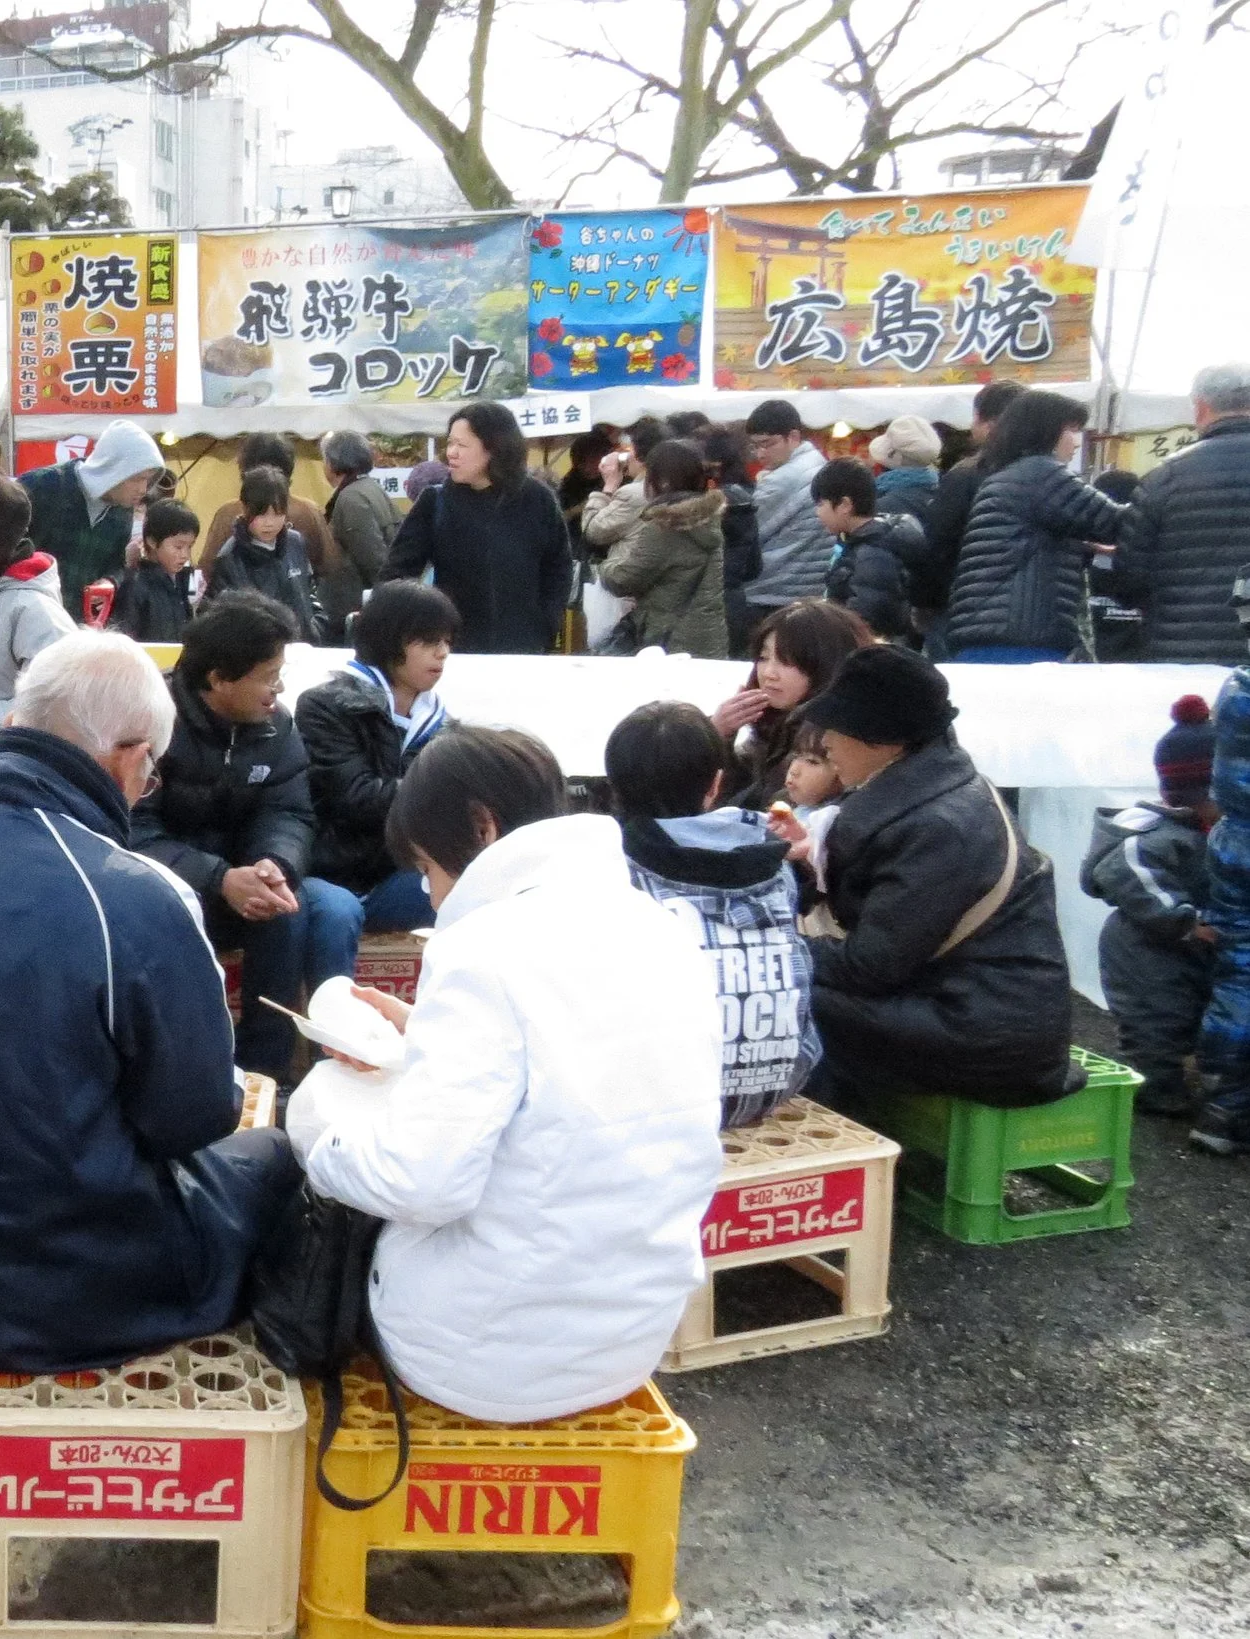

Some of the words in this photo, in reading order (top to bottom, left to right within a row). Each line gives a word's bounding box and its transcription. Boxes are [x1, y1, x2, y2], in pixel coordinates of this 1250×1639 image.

[579, 226, 655, 246] 谷ちゃんの
[530, 276, 699, 304] サーターアンダギー
[41, 302, 62, 357] 栗の実が
[755, 265, 1055, 373] 広島焼
[19, 310, 38, 410] 簡単に取れます
[308, 336, 500, 397] コロッケ
[702, 943, 793, 994] TREET
[702, 1197, 859, 1251] アサヒビール
[402, 1483, 601, 1537] KIRIN
